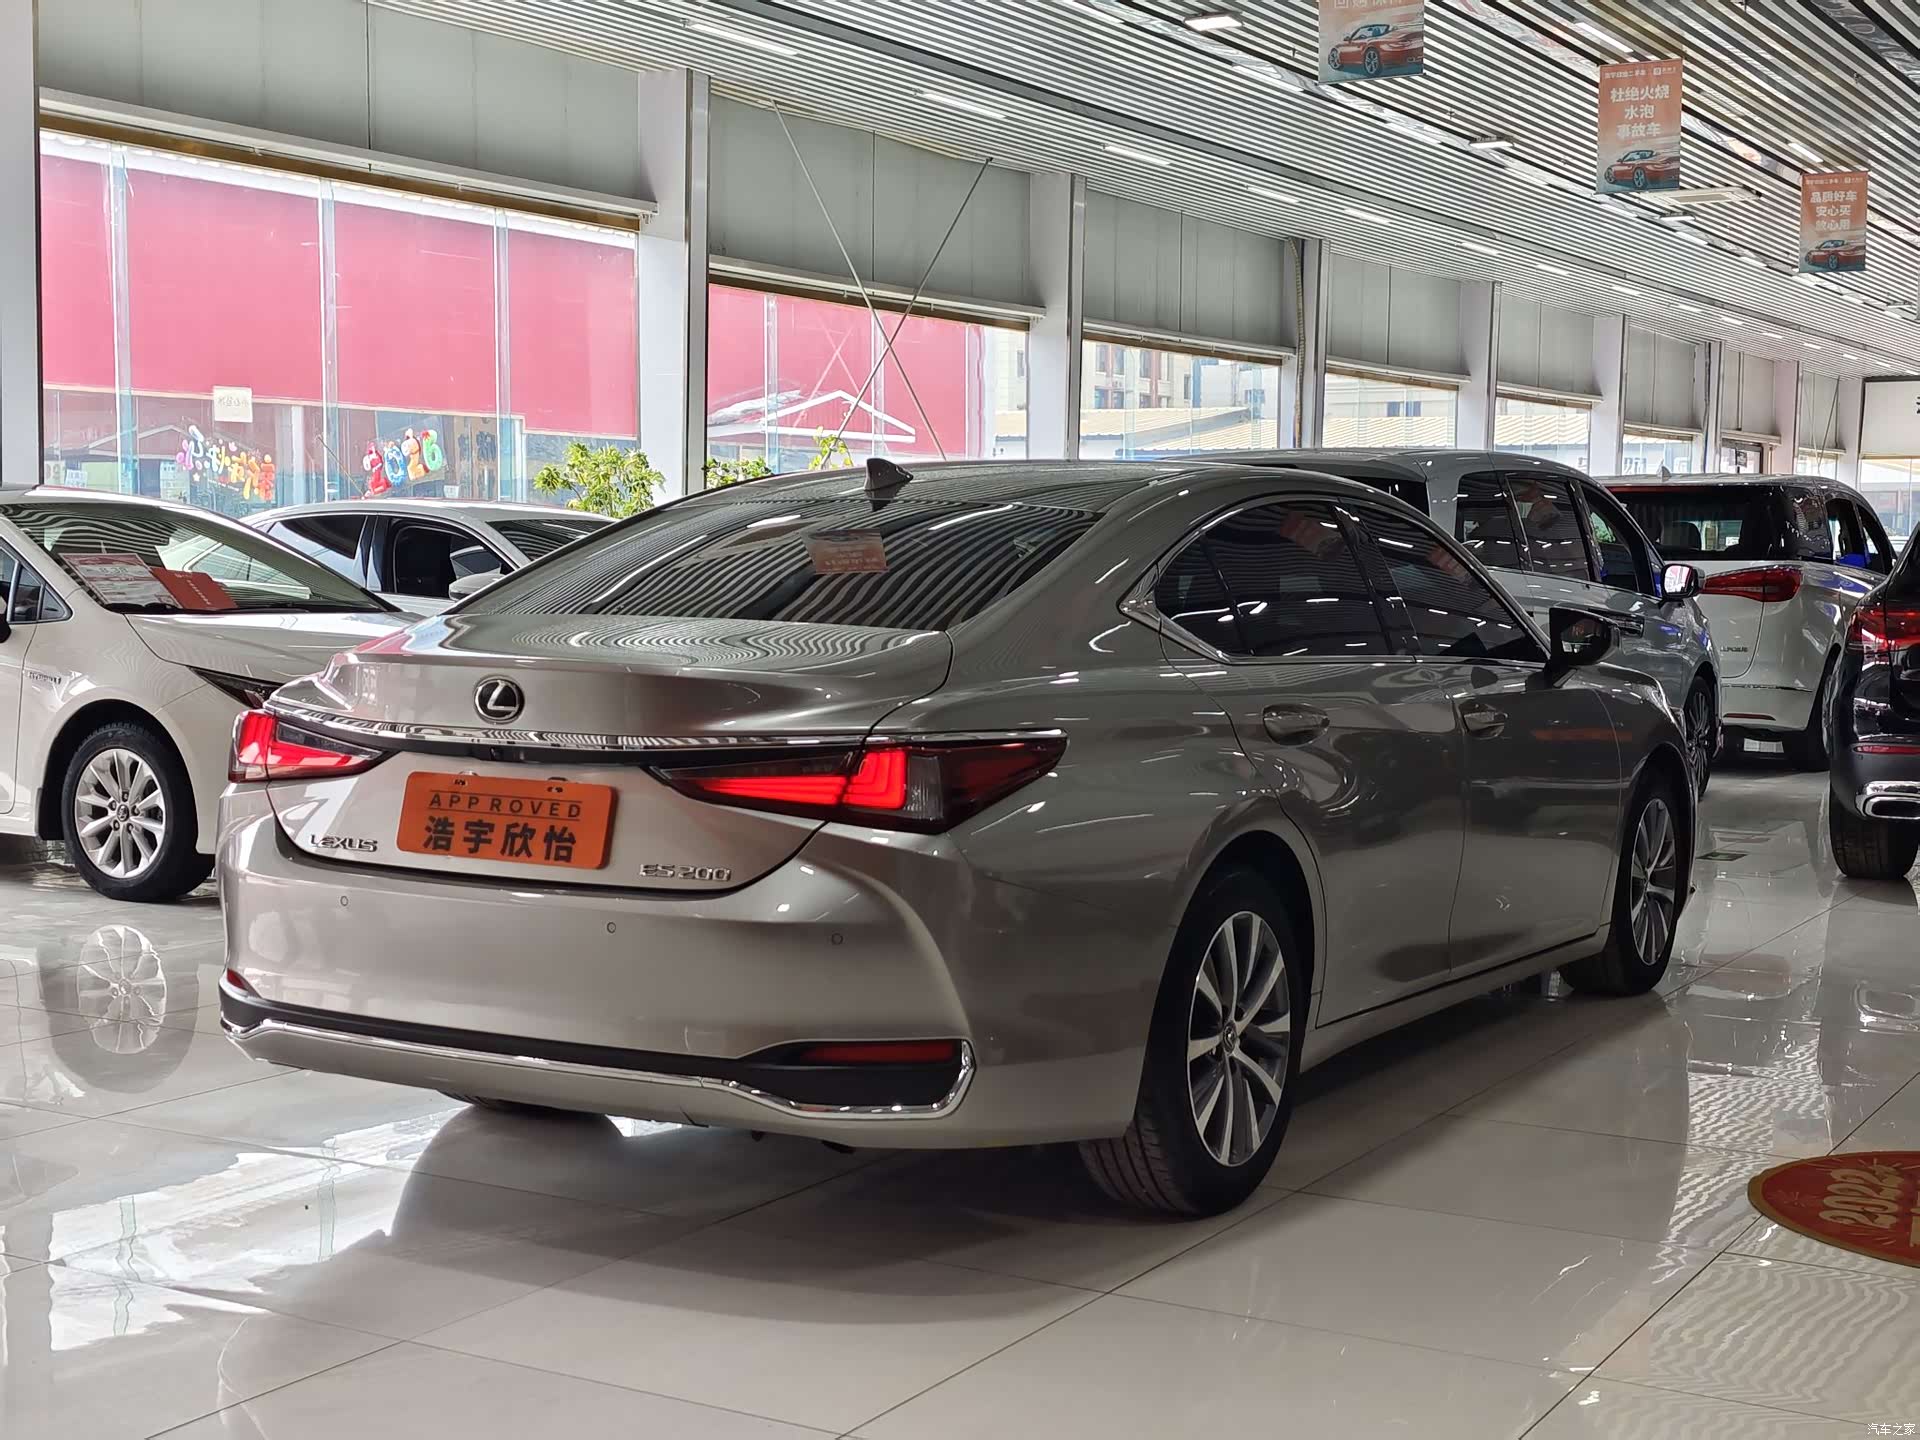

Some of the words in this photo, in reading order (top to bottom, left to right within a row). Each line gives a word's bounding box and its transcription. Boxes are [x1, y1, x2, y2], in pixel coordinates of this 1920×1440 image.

[1610, 84, 1670, 103] 杜绝火烧
[1624, 104, 1655, 120] 水泡
[1616, 122, 1661, 139] 事故车
[1810, 190, 1857, 203] 品质好车
[1816, 205, 1851, 217] 安心买
[429, 793, 581, 818] APPROVED
[309, 834, 378, 852] LEXUS
[423, 815, 577, 863] 浩宇欣怡
[640, 864, 675, 878] ES
[678, 865, 731, 882] 200
